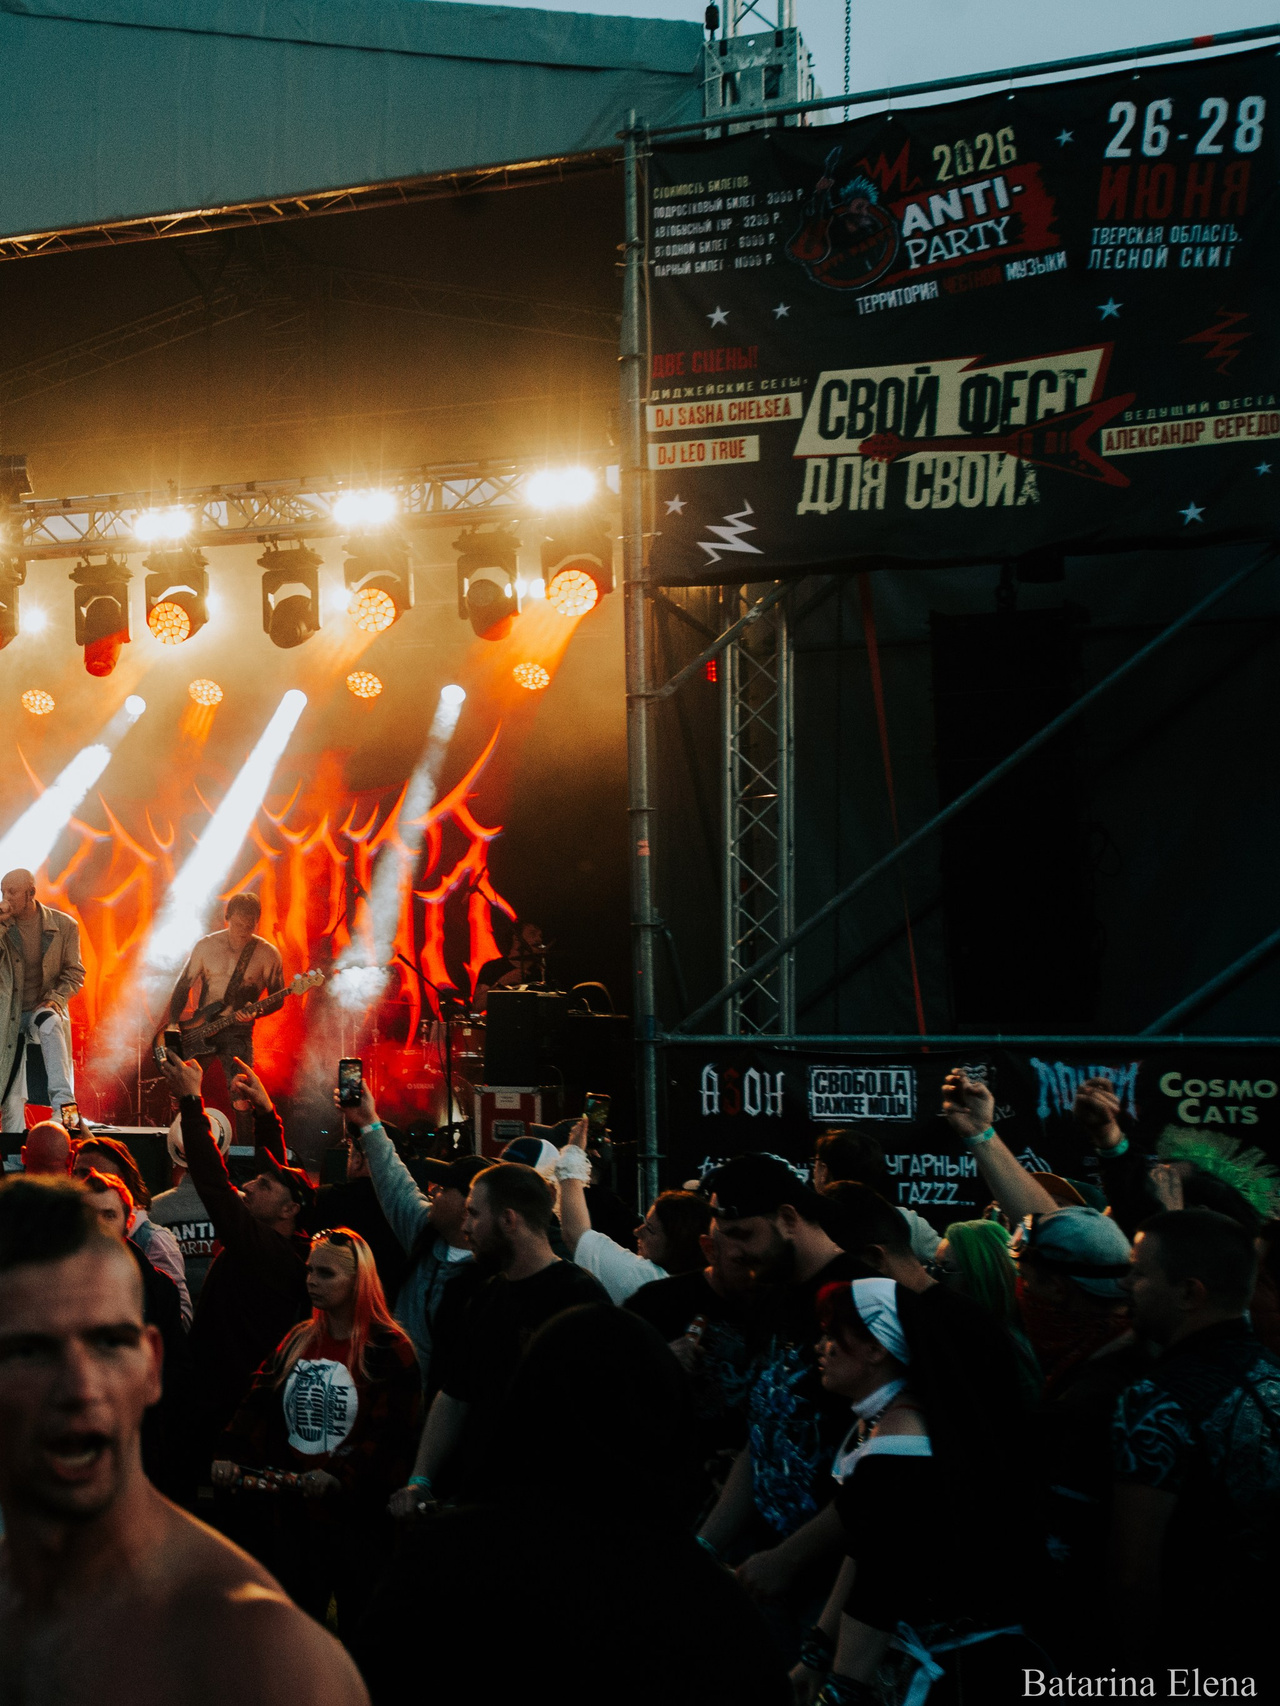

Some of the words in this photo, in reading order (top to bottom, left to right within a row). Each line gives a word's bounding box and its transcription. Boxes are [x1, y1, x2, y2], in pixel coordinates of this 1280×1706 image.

[1103, 95, 1267, 159] 26-28
[932, 125, 1018, 183] 2026
[726, 195, 756, 211] БИЛЕТ
[1096, 160, 1251, 220] ИЮНЯ
[902, 176, 1023, 238] ANTI-
[699, 238, 729, 254] БИЛЕТ
[904, 215, 1011, 270] PARTY
[1091, 225, 1165, 246] ТВЕРСКАЯ
[694, 258, 725, 274] БИЛЕТ
[1087, 244, 1170, 270] ЛЕСНОЙ
[1178, 245, 1236, 269] СКИТ
[855, 280, 940, 315] ТЕРРИТОРИЯ
[1004, 250, 1068, 282] МУЗЫКИ
[651, 381, 755, 401] ДИДЖЕЙСКИЕ
[819, 366, 940, 440] СВОЙ
[958, 368, 1087, 434] ФЕСТ
[655, 408, 673, 428] DJ
[678, 403, 724, 426] SASHA
[728, 397, 792, 421] CHELSEA
[1123, 400, 1210, 422] ВЕДУЩИЙ
[1105, 420, 1205, 451] АЛЕКСАНДР
[658, 446, 676, 465] DJ
[680, 442, 706, 463] LEO
[711, 439, 746, 461] TRUE
[796, 456, 889, 516] ДЛЯ
[814, 1071, 908, 1096] СВОБОДА
[816, 1096, 865, 1115] ВАЖНЕЕ
[883, 1150, 978, 1179] УГАРНЫЙ
[171, 1222, 215, 1241] ANTI
[180, 1240, 214, 1255] ARTY
